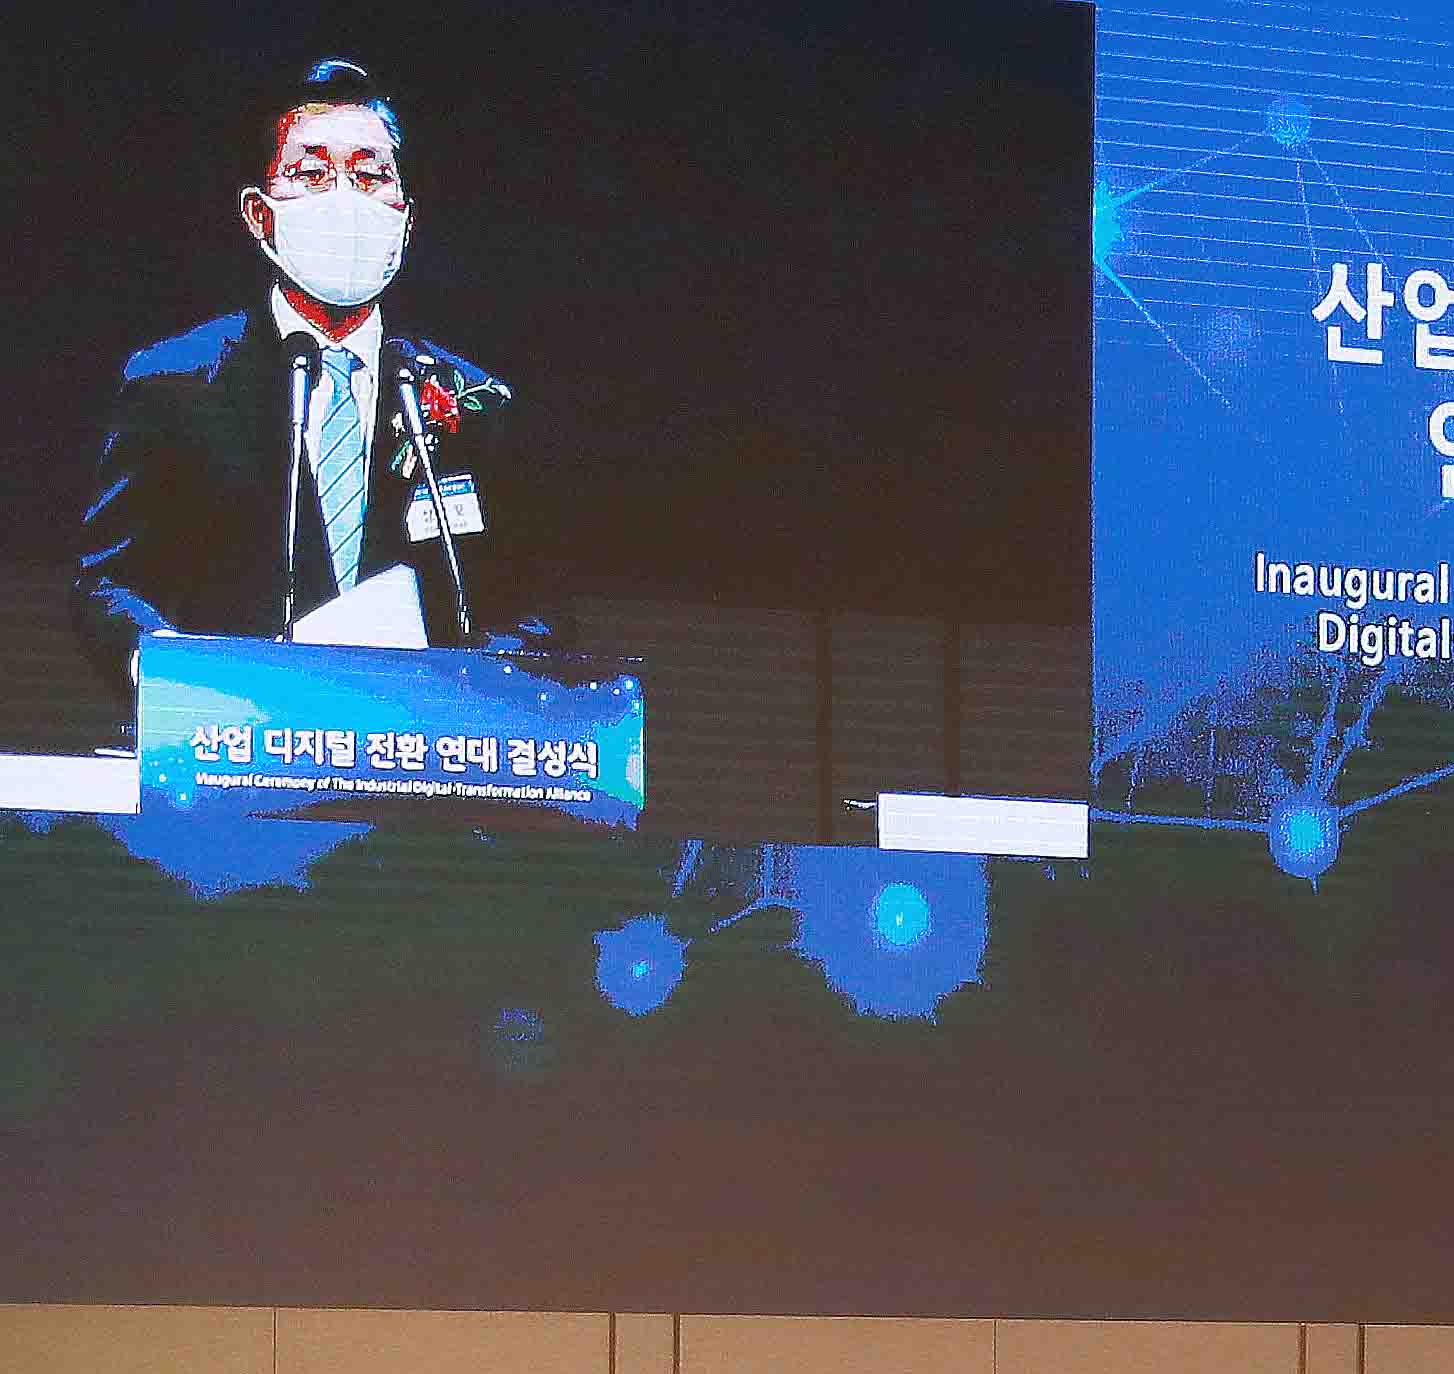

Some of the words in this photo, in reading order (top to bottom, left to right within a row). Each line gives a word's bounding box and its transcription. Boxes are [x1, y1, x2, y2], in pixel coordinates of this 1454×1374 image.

[1254, 552, 1449, 608] Inaugural
[190, 725, 253, 764] 산업
[263, 728, 357, 769] 디지털
[365, 732, 428, 771] 전환
[435, 735, 498, 774] 연대
[506, 739, 598, 780] 결성식
